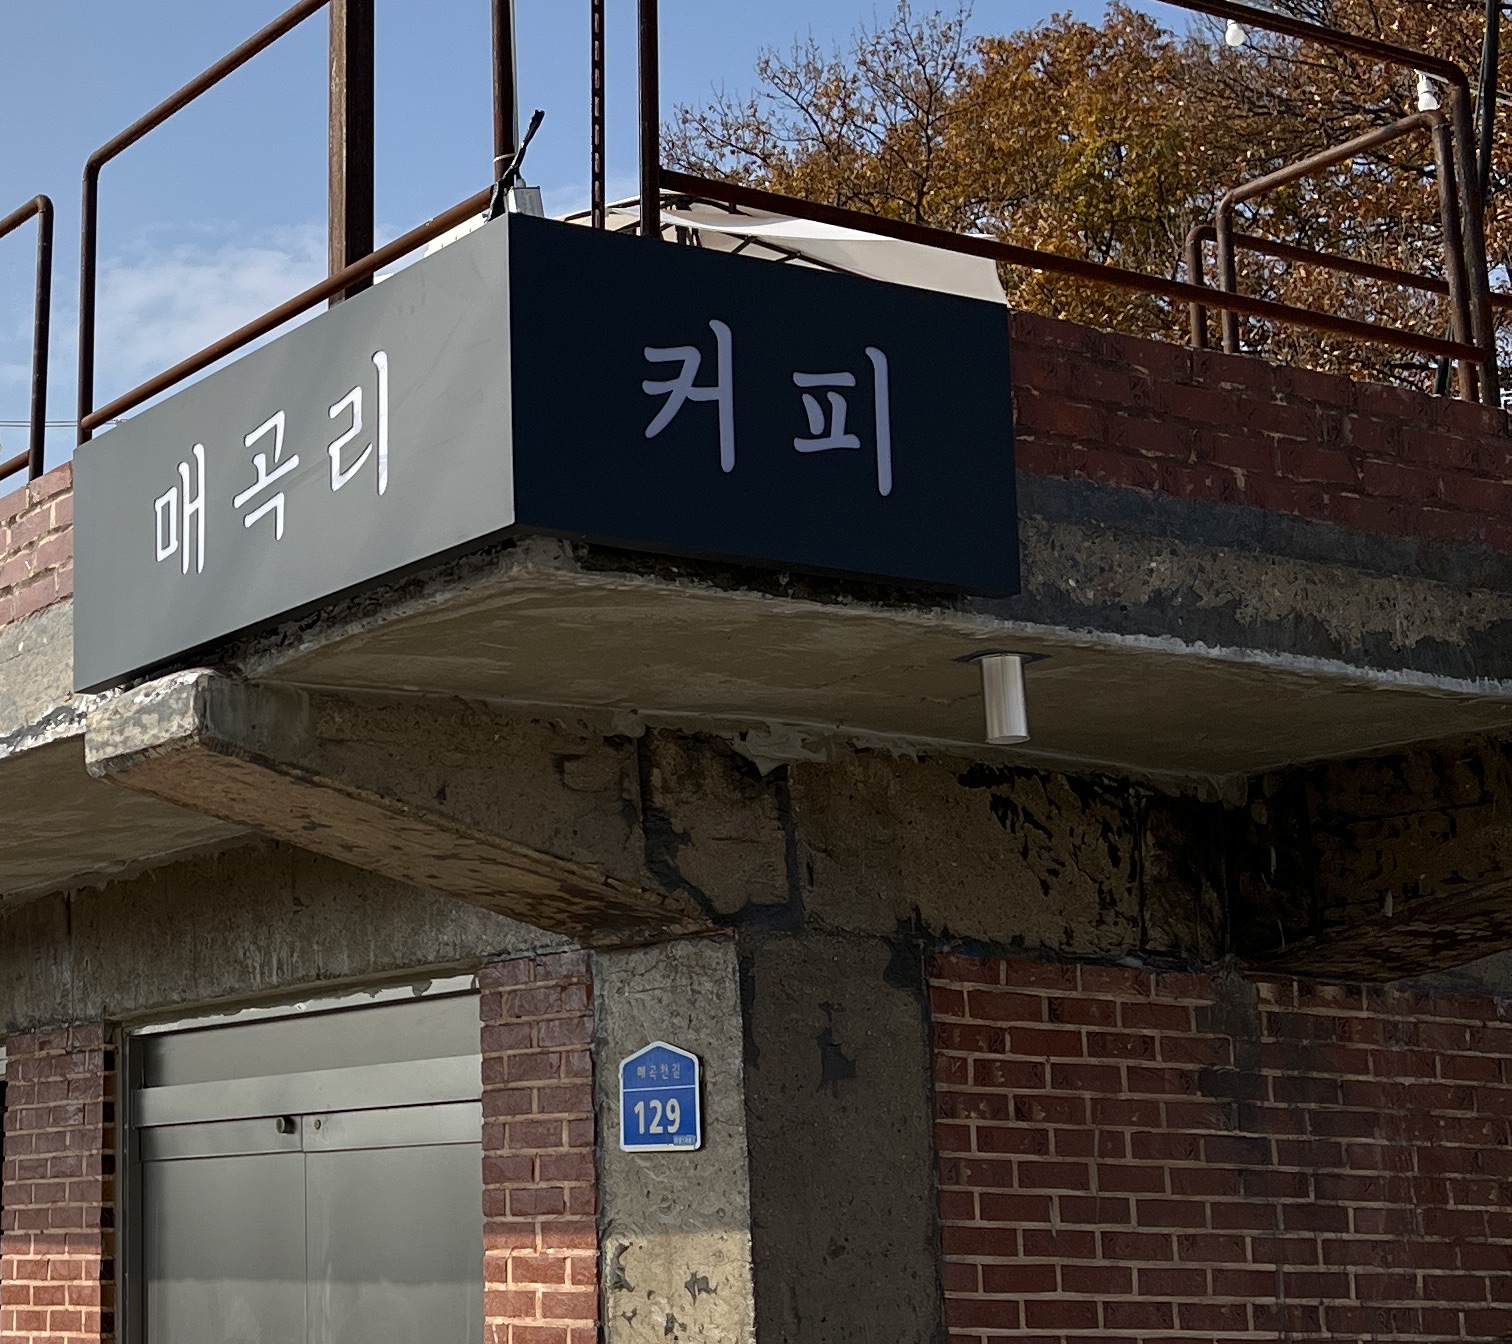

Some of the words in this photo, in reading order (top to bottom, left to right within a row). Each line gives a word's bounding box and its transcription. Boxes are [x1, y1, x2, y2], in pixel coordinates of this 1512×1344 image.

[152, 349, 391, 576] 매곡리
[641, 318, 895, 498] 커피
[633, 1097, 681, 1135] 129
